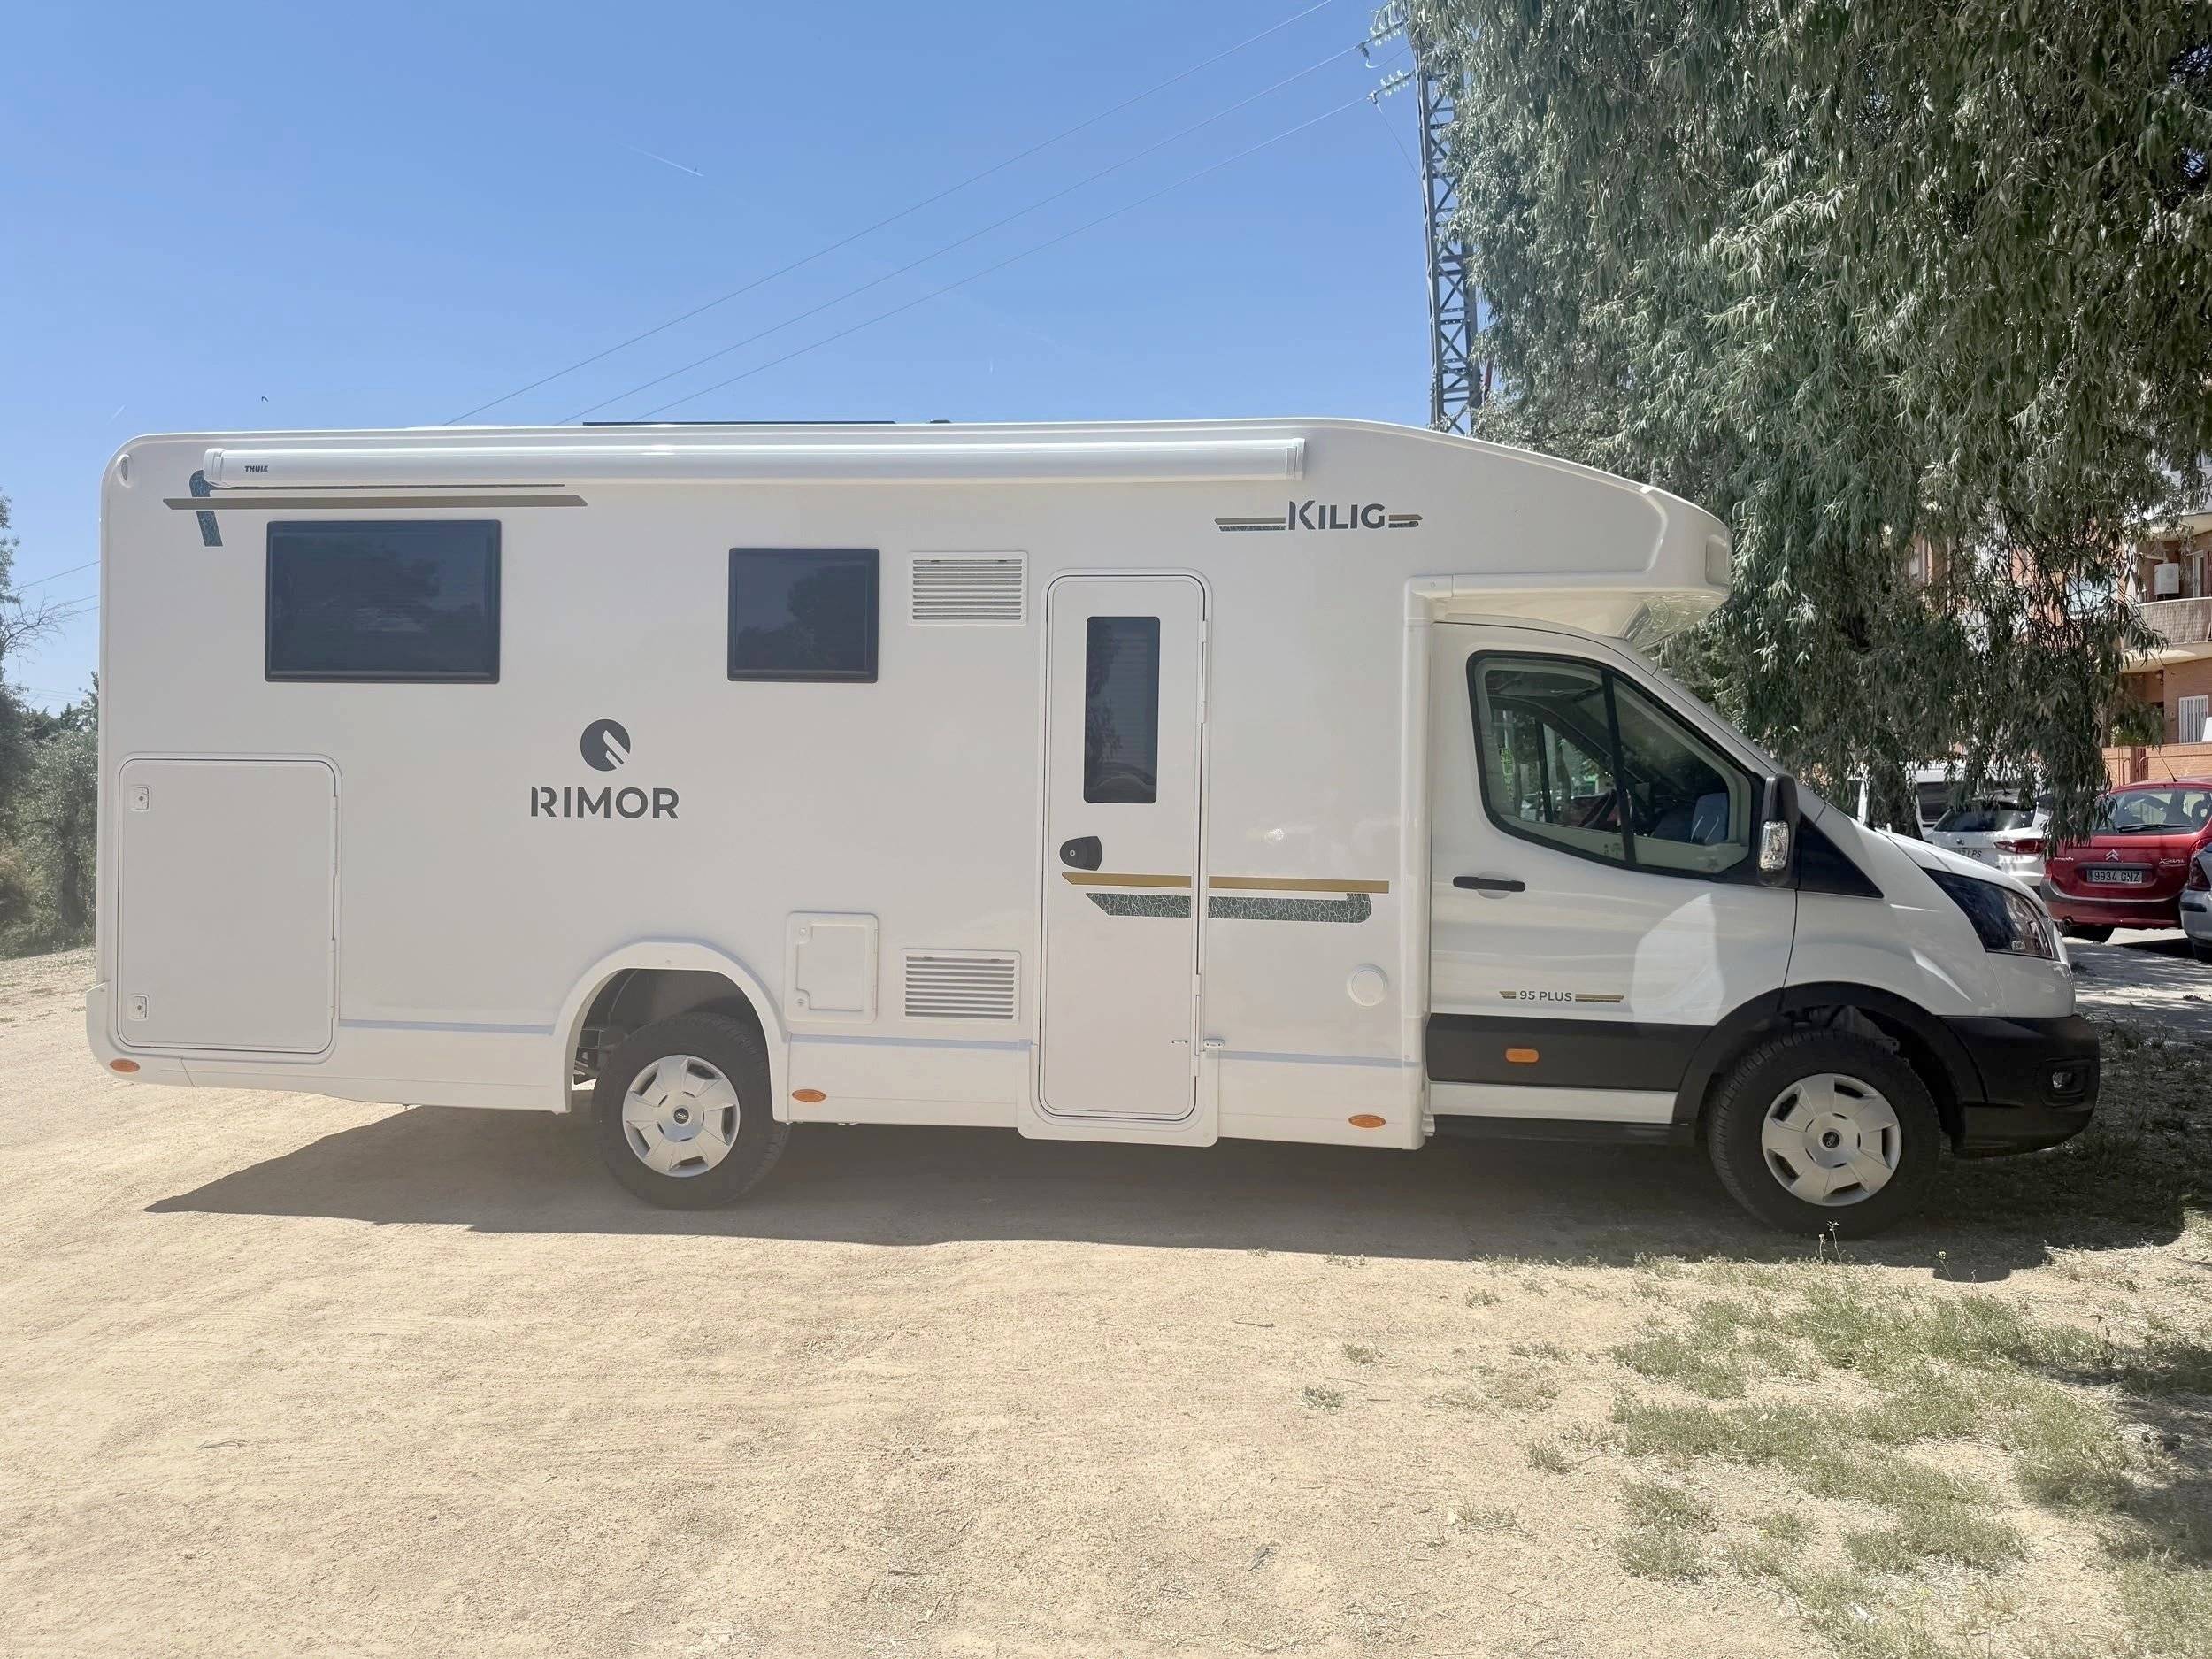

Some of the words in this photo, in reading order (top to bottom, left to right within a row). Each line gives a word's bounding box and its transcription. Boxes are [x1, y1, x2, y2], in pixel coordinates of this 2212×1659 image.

[1288, 500, 1386, 531] KILIG
[531, 786, 680, 819] RIMOR
[2093, 871, 2117, 881] 9934
[2120, 872, 2140, 883] GMZ
[1519, 990, 1536, 1001] 95
[1539, 991, 1573, 1002] PLUS
